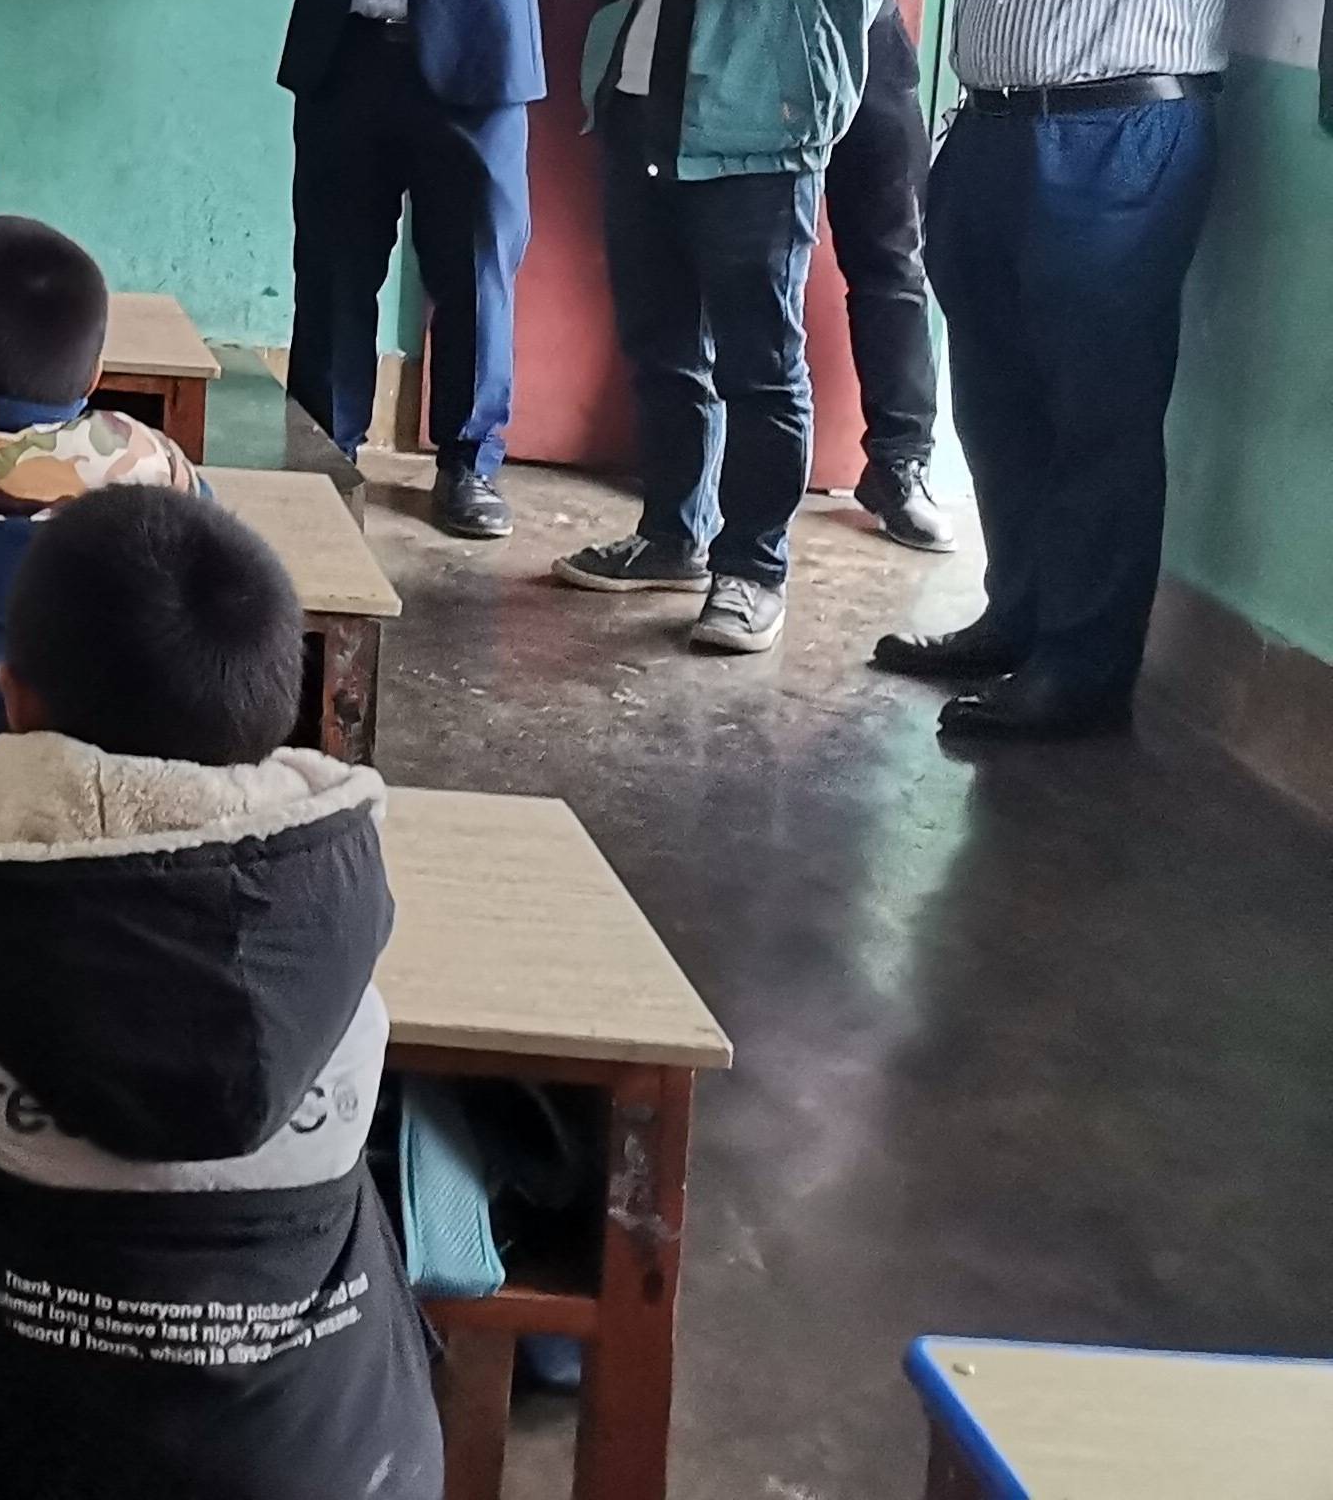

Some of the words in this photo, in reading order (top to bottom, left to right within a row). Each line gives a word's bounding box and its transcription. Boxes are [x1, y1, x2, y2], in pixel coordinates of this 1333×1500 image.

[5, 1269, 52, 1298] Thank
[57, 1285, 90, 1307] you
[94, 1293, 113, 1311] to
[116, 1299, 204, 1322] everyone
[207, 1301, 243, 1320] that
[49, 1302, 90, 1332] long
[93, 1315, 157, 1339] sleeve
[161, 1321, 198, 1342] last
